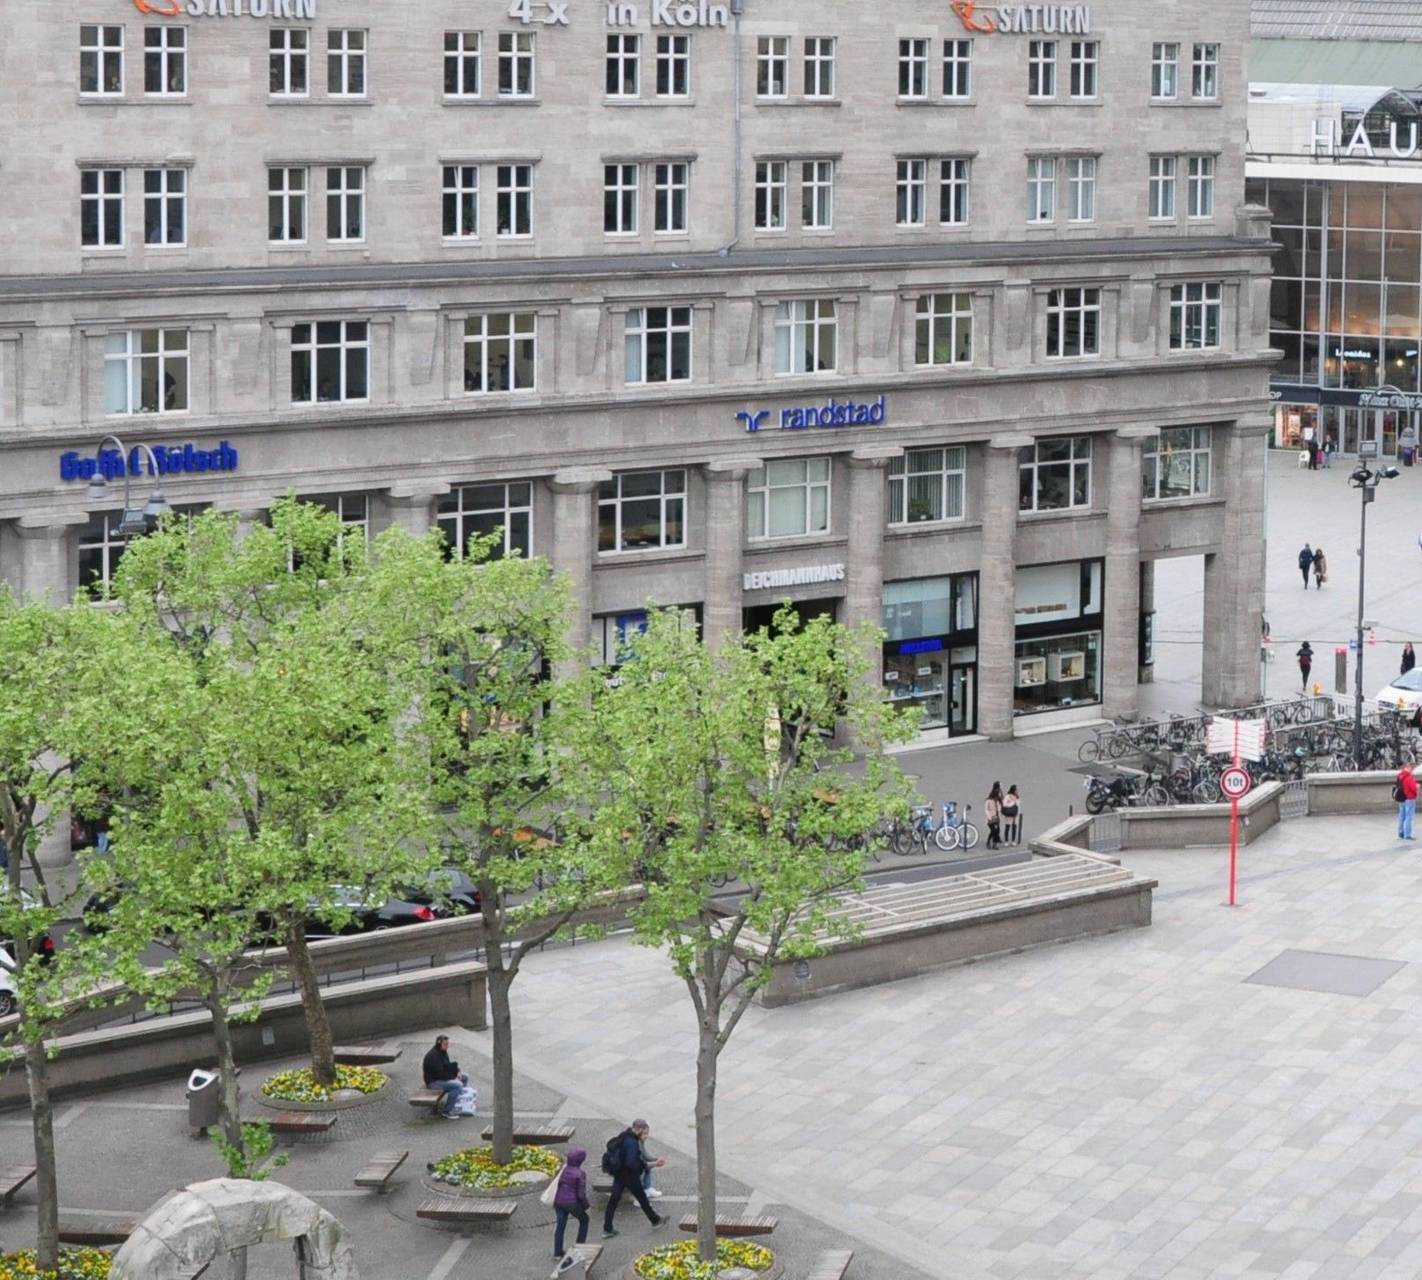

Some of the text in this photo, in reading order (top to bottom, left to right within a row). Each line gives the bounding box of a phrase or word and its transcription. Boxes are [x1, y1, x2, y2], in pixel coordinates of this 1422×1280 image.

[508, 0, 533, 23] 4
[607, 2, 637, 26] in
[652, 0, 728, 26] Köln
[999, 4, 1090, 34] SATURN
[779, 394, 885, 430] randstad
